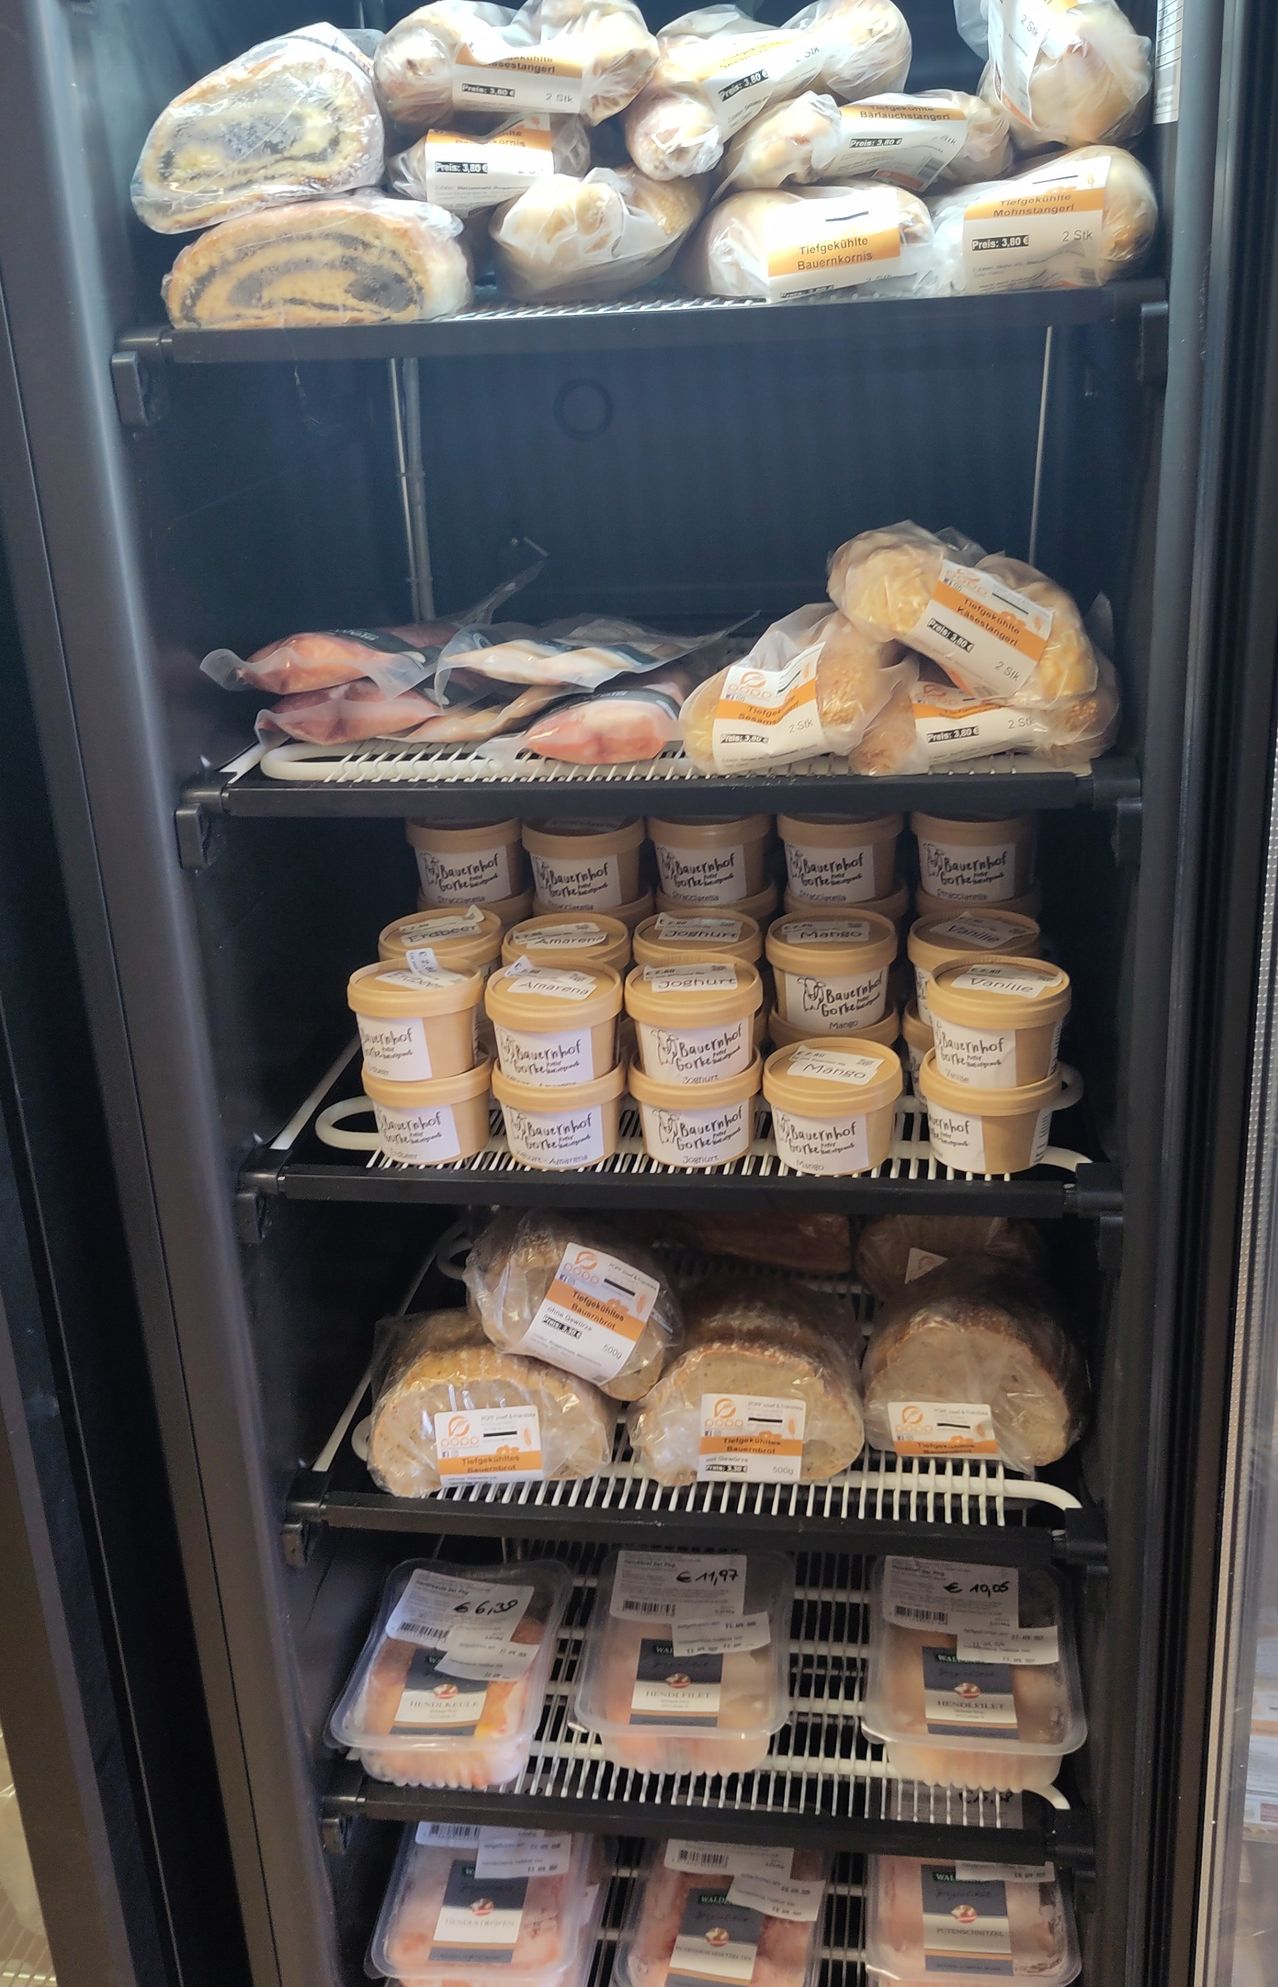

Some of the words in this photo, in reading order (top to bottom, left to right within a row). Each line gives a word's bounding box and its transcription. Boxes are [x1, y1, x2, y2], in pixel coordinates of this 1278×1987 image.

[546, 92, 552, 101] 2
[555, 94, 575, 104] Stk
[1001, 193, 1072, 208] Tiefgekühlte
[992, 204, 1075, 219] Mohnstangerl
[972, 239, 1000, 251] Preis:
[1001, 237, 1021, 250] 3,80
[1061, 231, 1071, 243] 2
[1073, 229, 1094, 242] Stk
[798, 236, 870, 257] Tiefgekühlte
[796, 251, 874, 271] Bauernkornis
[962, 597, 1021, 635] Tiefgekühlte
[956, 605, 1019, 648] Käsestangerl
[995, 660, 1003, 671] 2
[1004, 664, 1022, 681] Stk
[788, 724, 796, 735] 2
[797, 718, 814, 731] Stk
[1007, 719, 1015, 730] 2
[927, 732, 952, 744] Preis:
[438, 852, 499, 879] Bauernhof
[675, 852, 736, 877] Bauernhof
[803, 851, 864, 878] Bauernhof
[944, 850, 1008, 873] Bauernhof
[547, 861, 609, 887] Bauernhof
[407, 922, 476, 944] Erdbeer
[535, 932, 609, 945] Amarena
[665, 928, 737, 939] Joghurt
[800, 930, 863, 940] Mango
[947, 924, 1000, 942] Vanille
[520, 980, 589, 996] Amarena
[658, 978, 737, 989] Joghurt
[969, 977, 1034, 993] Vanille
[679, 1022, 743, 1058] Bauernhof
[942, 1037, 1005, 1055] Bauernhof
[516, 1038, 582, 1061] Bauernhof
[802, 1062, 867, 1080] Mango
[682, 1074, 719, 1086] Joghurt
[527, 1112, 593, 1138] Bauernhof
[680, 1104, 744, 1138] Bauernhof
[791, 1121, 857, 1142] Bauernhof
[682, 1154, 720, 1164] Joghurt
[572, 1291, 625, 1322] Tiefgekühltes
[571, 1303, 616, 1330] Bauernbrot
[602, 1343, 623, 1360] 500g
[723, 1437, 781, 1447] Tiefgekühltes
[726, 1446, 776, 1455] Bauernbrot
[461, 1454, 521, 1465] Tiefgekühltes
[466, 1464, 517, 1473] Bauernbrot
[772, 1466, 794, 1476] 500g
[676, 1570, 692, 1584] €
[694, 1569, 740, 1587] 11,97
[944, 1582, 963, 1594] €
[453, 1601, 471, 1614] €
